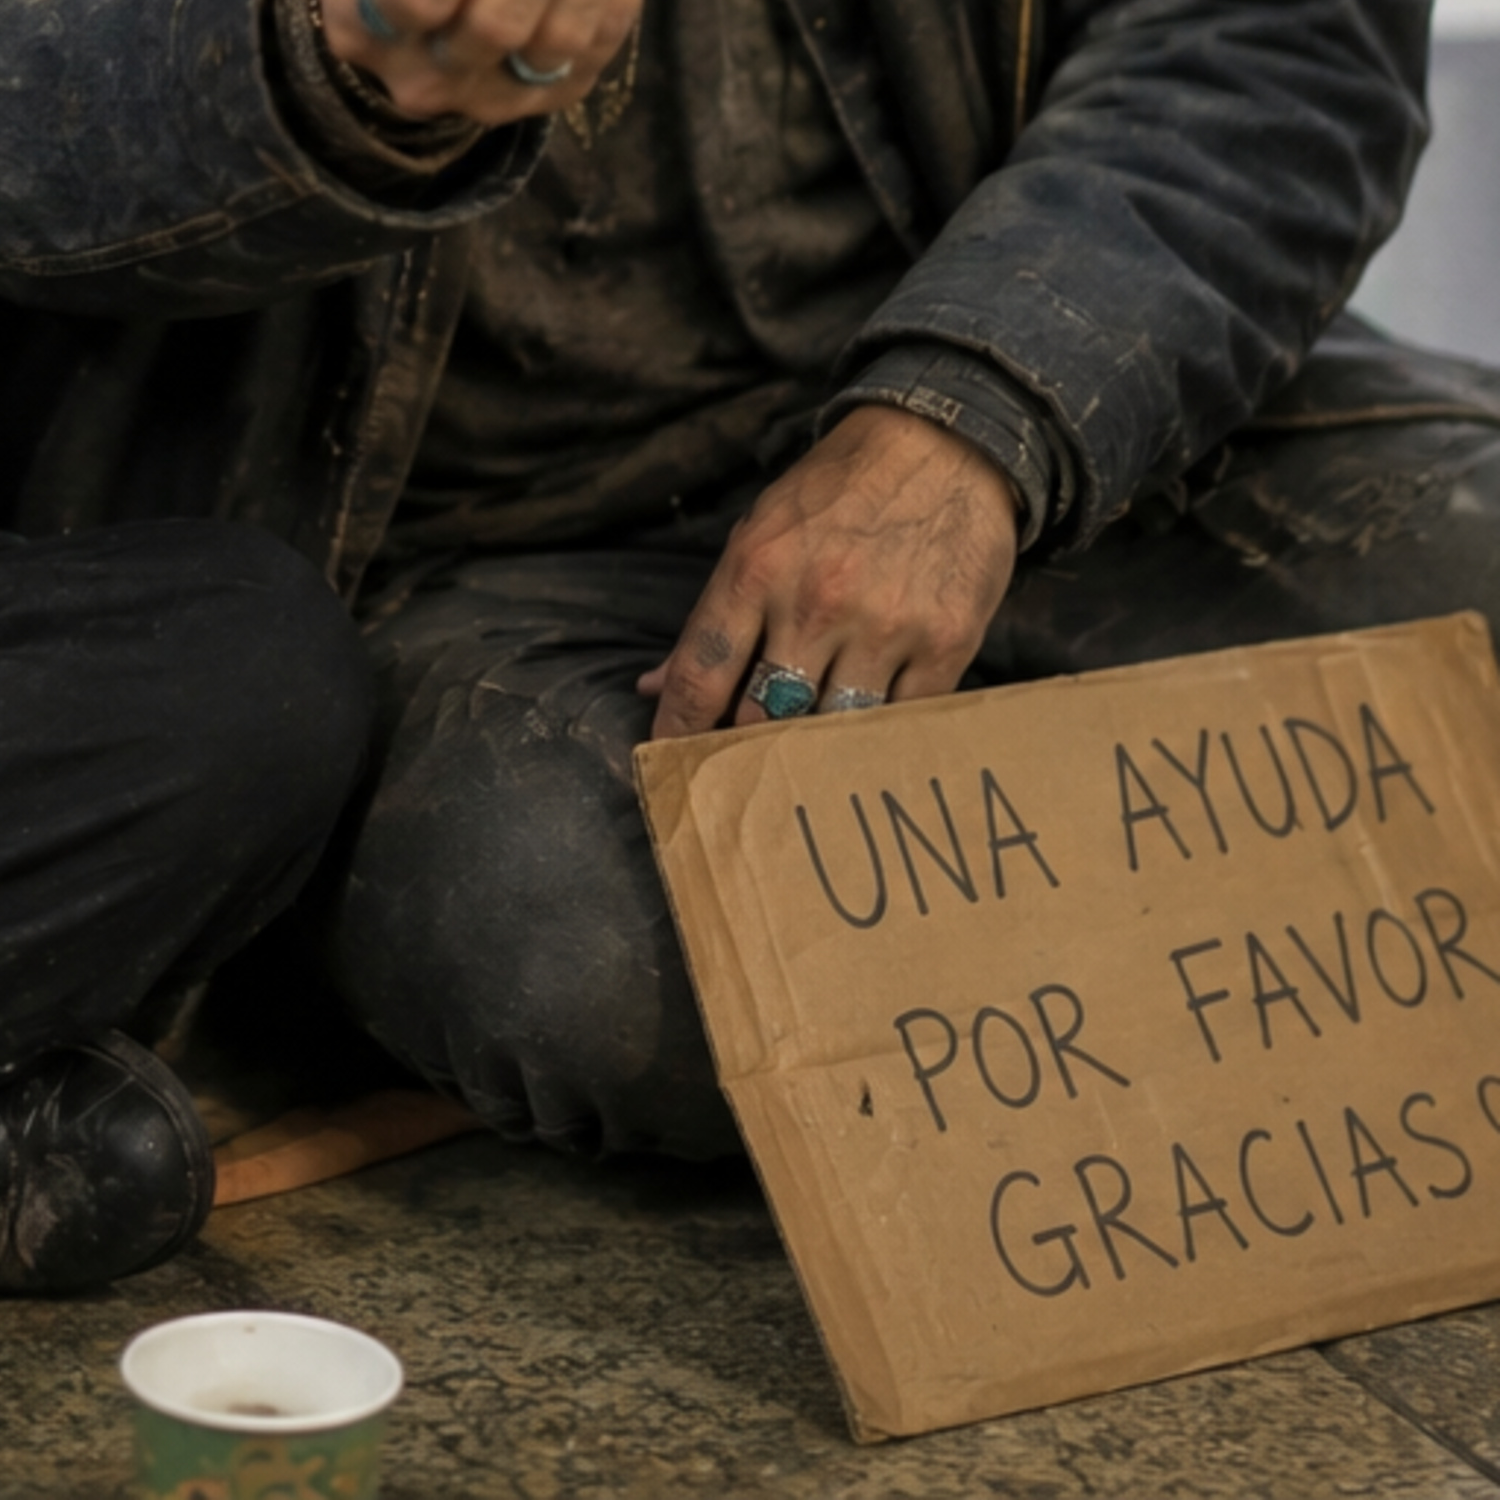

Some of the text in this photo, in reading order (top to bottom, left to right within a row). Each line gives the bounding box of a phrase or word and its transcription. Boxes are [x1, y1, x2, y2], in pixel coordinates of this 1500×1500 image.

[794, 702, 1435, 930] UNA AYUDA
[892, 887, 1500, 1134] POR FAVOR
[989, 1091, 1473, 1298] GRACIAS
